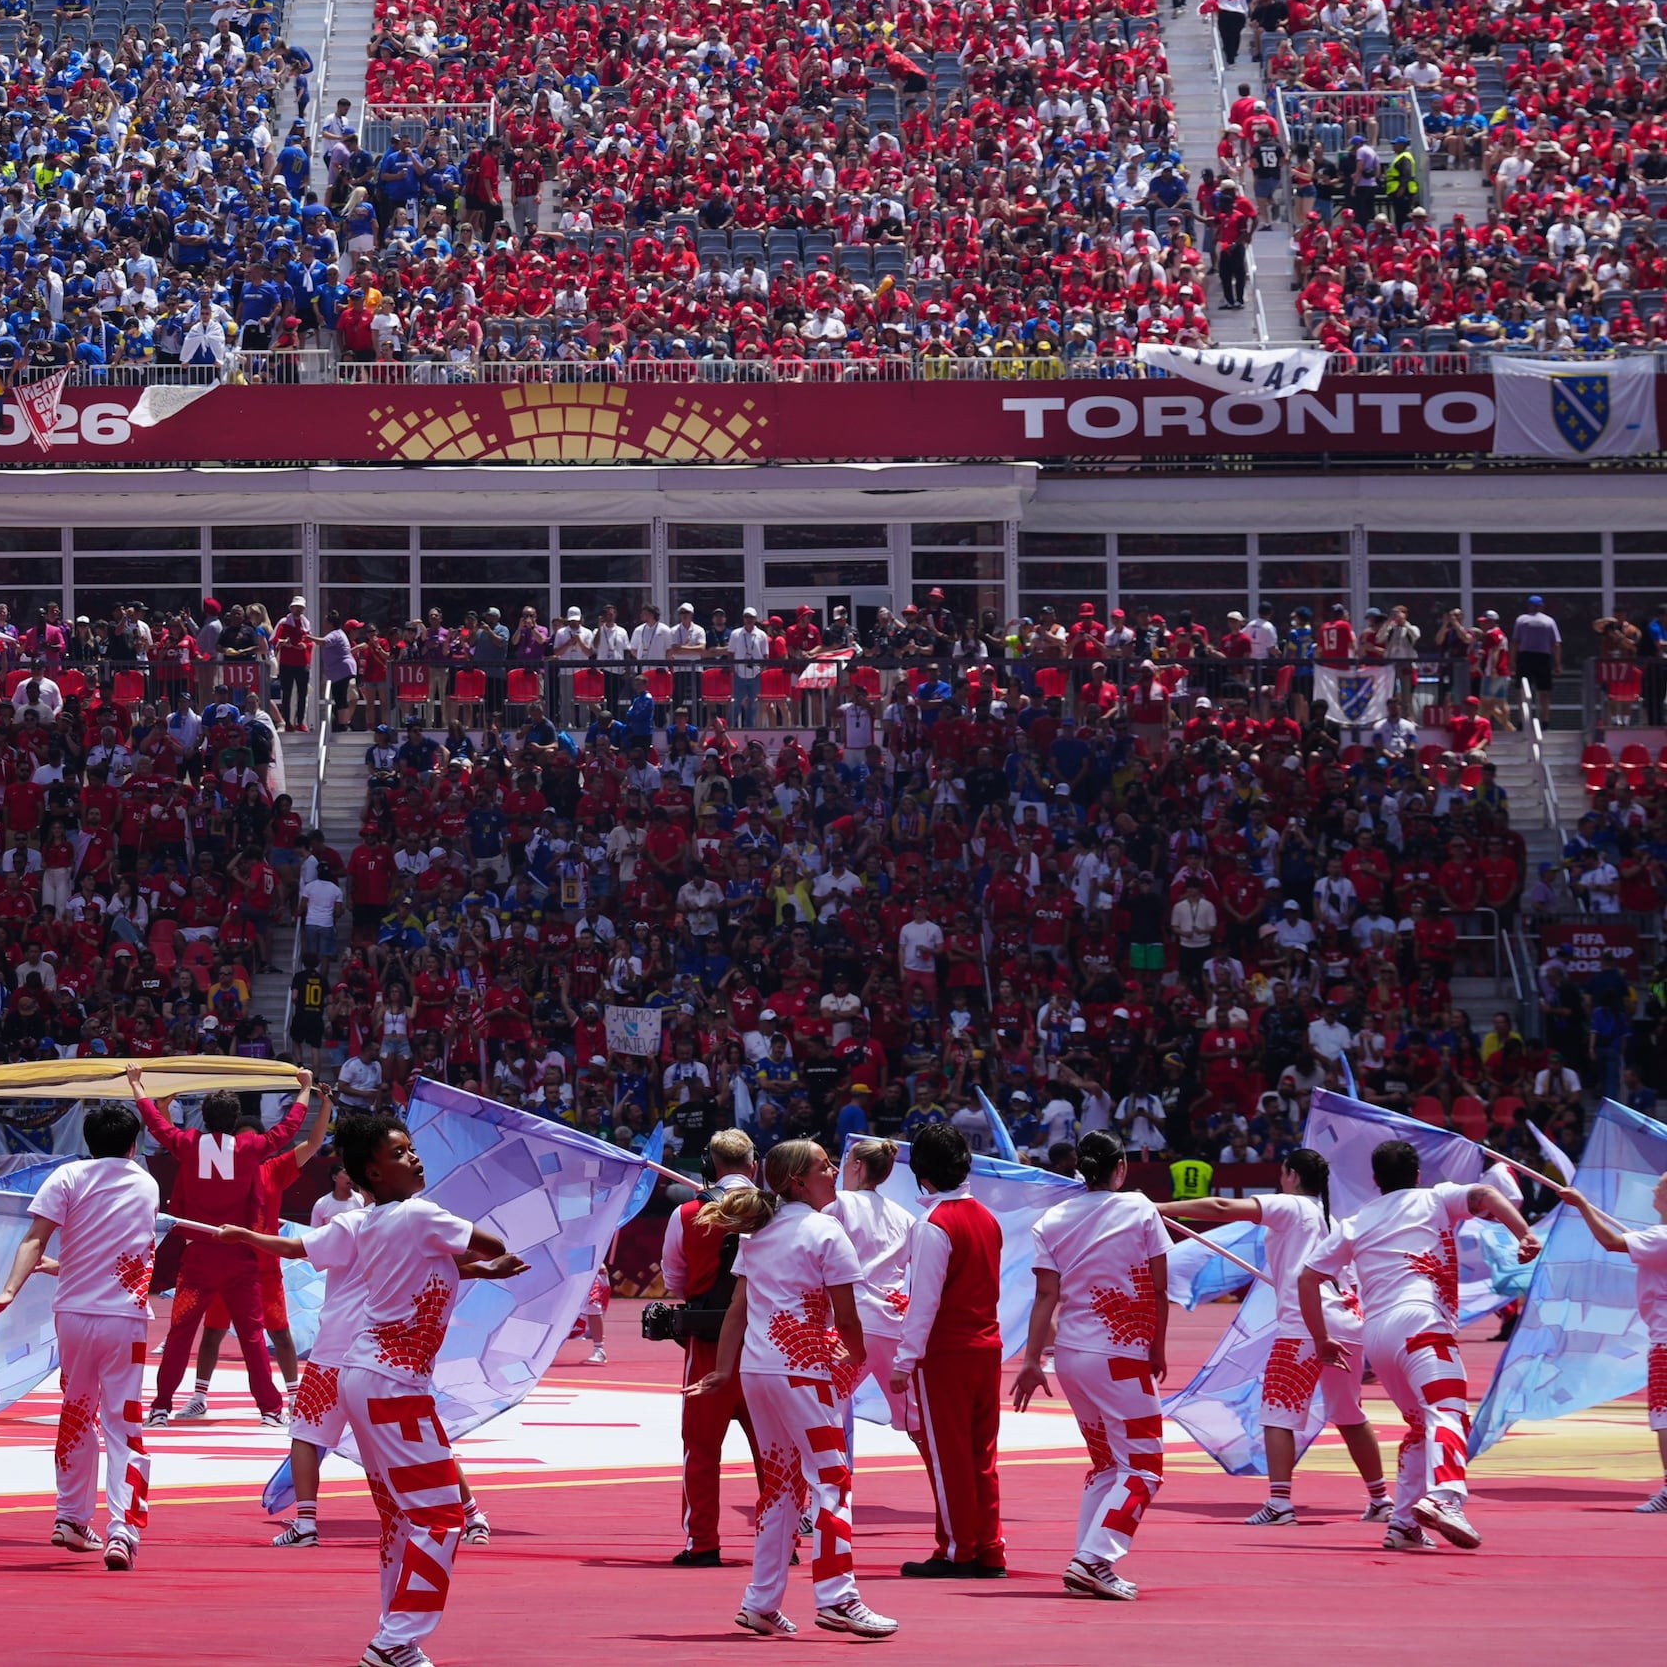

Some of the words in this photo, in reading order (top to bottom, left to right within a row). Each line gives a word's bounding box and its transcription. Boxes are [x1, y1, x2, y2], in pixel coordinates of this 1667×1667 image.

[1261, 151, 1277, 167] 19
[1002, 391, 1495, 438] TORONTO
[1320, 629, 1335, 650] 19
[229, 667, 254, 683] 115
[399, 667, 423, 683] 116
[1601, 663, 1627, 679] 117
[1572, 933, 1606, 946] FIFA
[1547, 945, 1601, 959] WRLD
[305, 984, 321, 1006] 10
[198, 1133, 236, 1180] N
